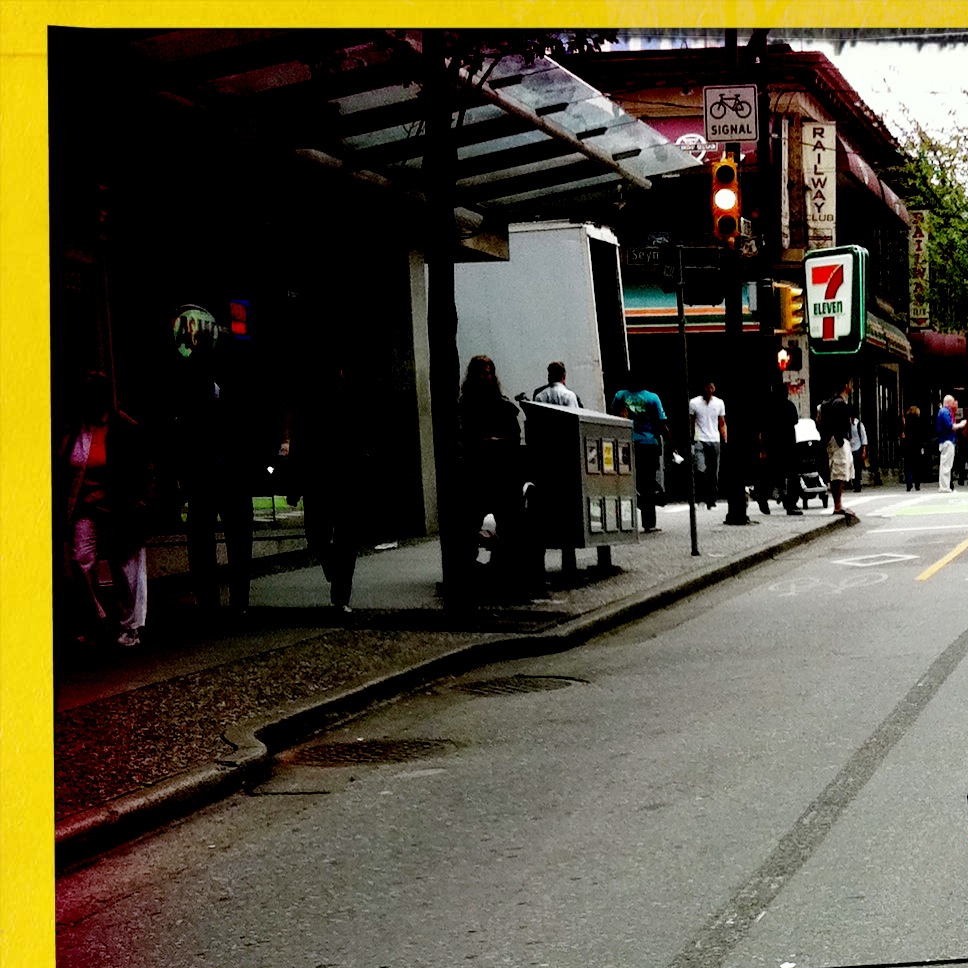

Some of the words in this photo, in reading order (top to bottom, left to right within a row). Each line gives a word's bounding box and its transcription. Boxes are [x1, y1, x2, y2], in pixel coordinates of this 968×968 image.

[711, 124, 753, 136] SIGNAL
[811, 126, 828, 214] RAILWAY
[811, 263, 845, 341] 7
